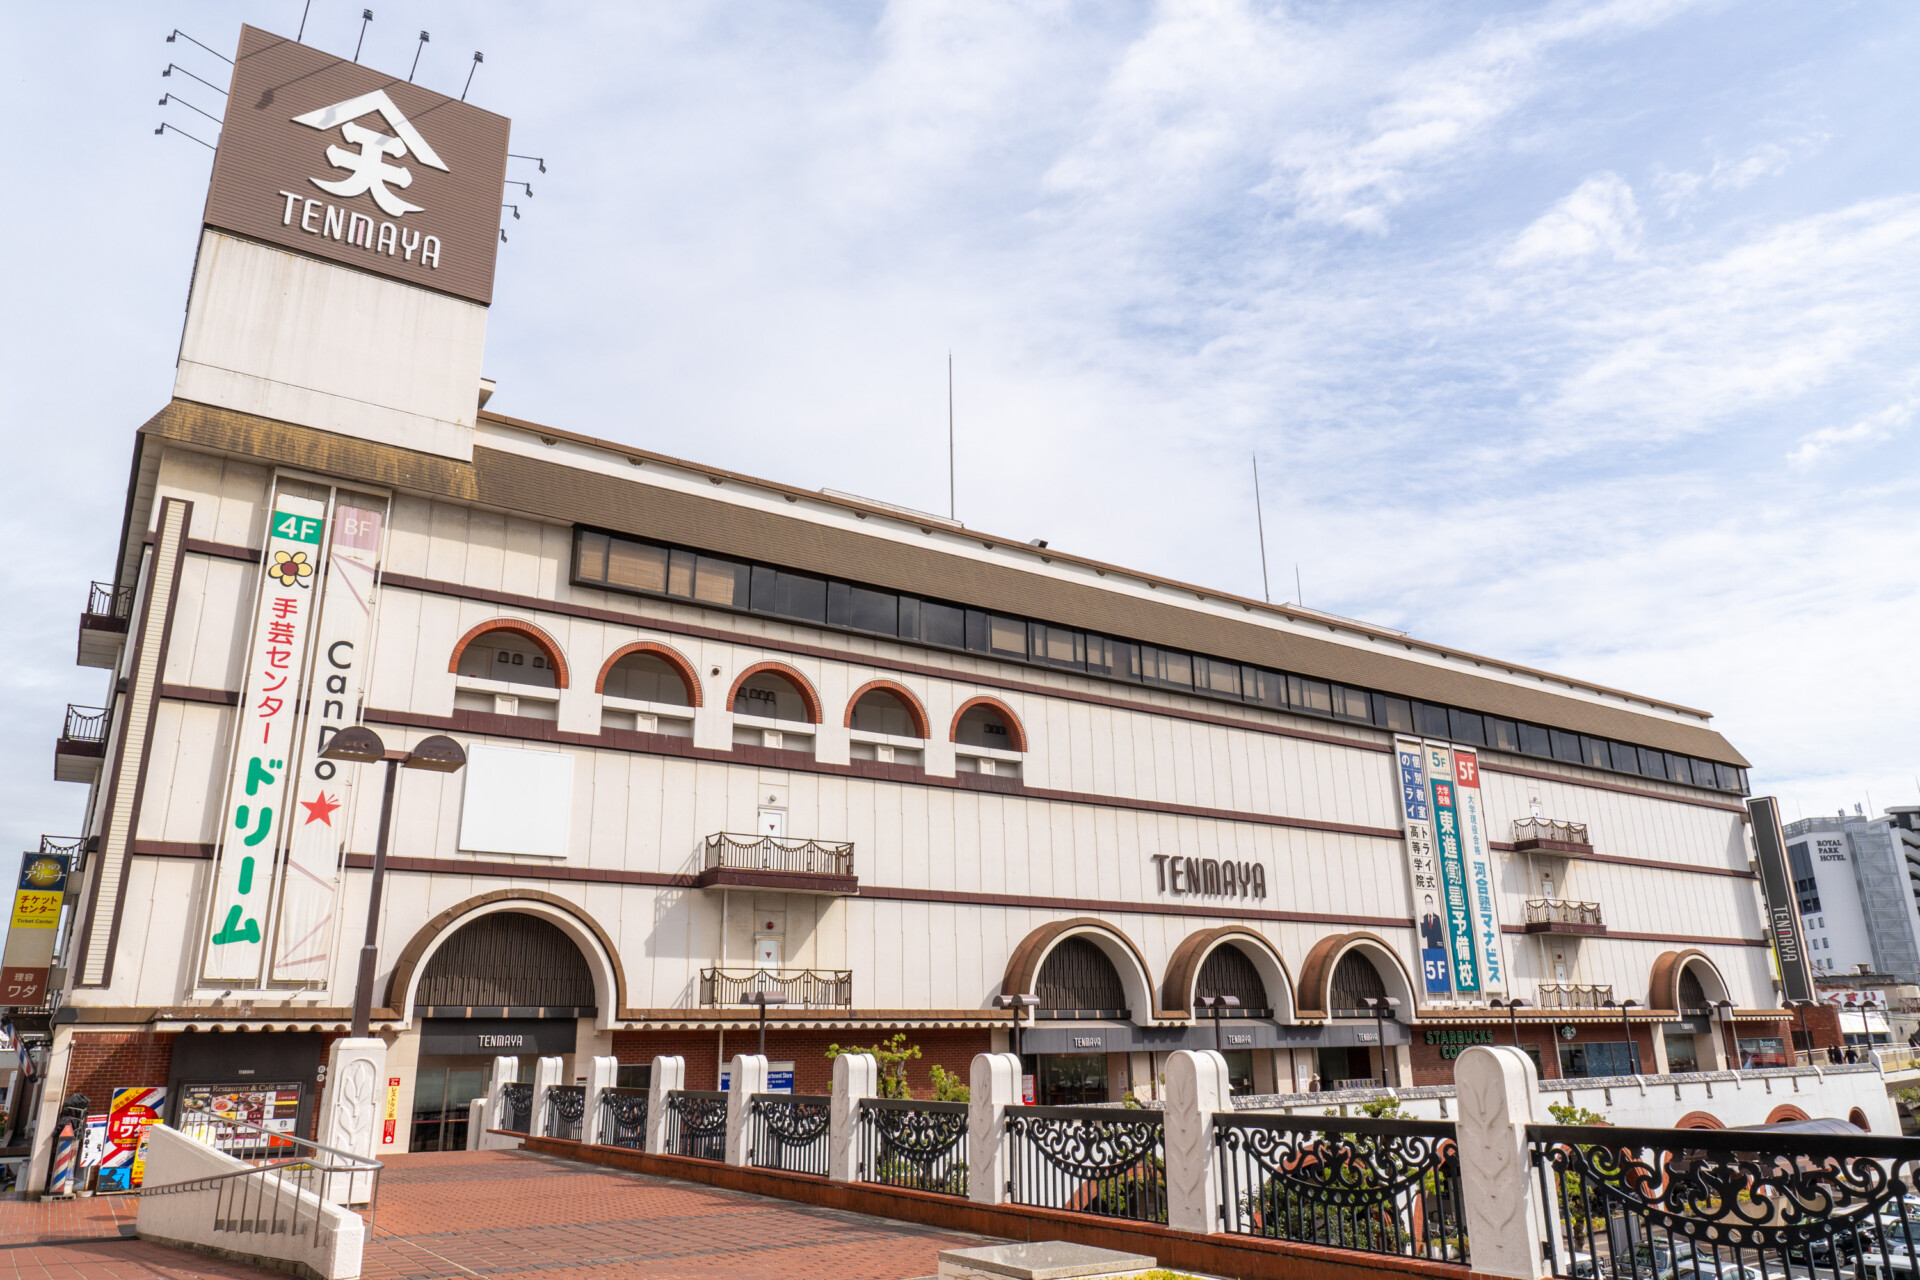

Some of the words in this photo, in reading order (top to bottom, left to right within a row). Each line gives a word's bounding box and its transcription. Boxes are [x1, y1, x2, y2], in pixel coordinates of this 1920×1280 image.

[279, 190, 441, 268] TENMAYA
[277, 516, 317, 540] 4F
[344, 518, 372, 537] BF
[258, 597, 298, 744] 手芸センター
[1432, 752, 1446, 767] 5F
[1459, 761, 1475, 781] 5F
[1401, 754, 1415, 817] のトライ
[1437, 785, 1449, 795] 大学
[1816, 839, 1842, 847] ROYAL
[212, 757, 283, 945] ドリーム
[1409, 825, 1425, 888] 高等学院
[1420, 826, 1436, 889] トライ式
[1820, 854, 1846, 862] HOTEL
[24, 870, 66, 882] アリーナ
[1152, 854, 1267, 899] TENMAYA
[21, 895, 58, 905] チケット
[19, 904, 56, 914] センター
[1473, 861, 1501, 983] 河合塾マナビス
[1773, 904, 1798, 962] TENMAYA
[14, 972, 34, 982] 理容
[1425, 960, 1446, 980] 5F
[8, 984, 37, 998] ワダ
[1828, 991, 1876, 1004] くすり
[478, 1034, 523, 1047] TENMAYA
[1074, 1037, 1102, 1047] TENMAYA
[1228, 1035, 1252, 1044] TENMAYA
[1426, 1030, 1493, 1045] STARBUCKS
